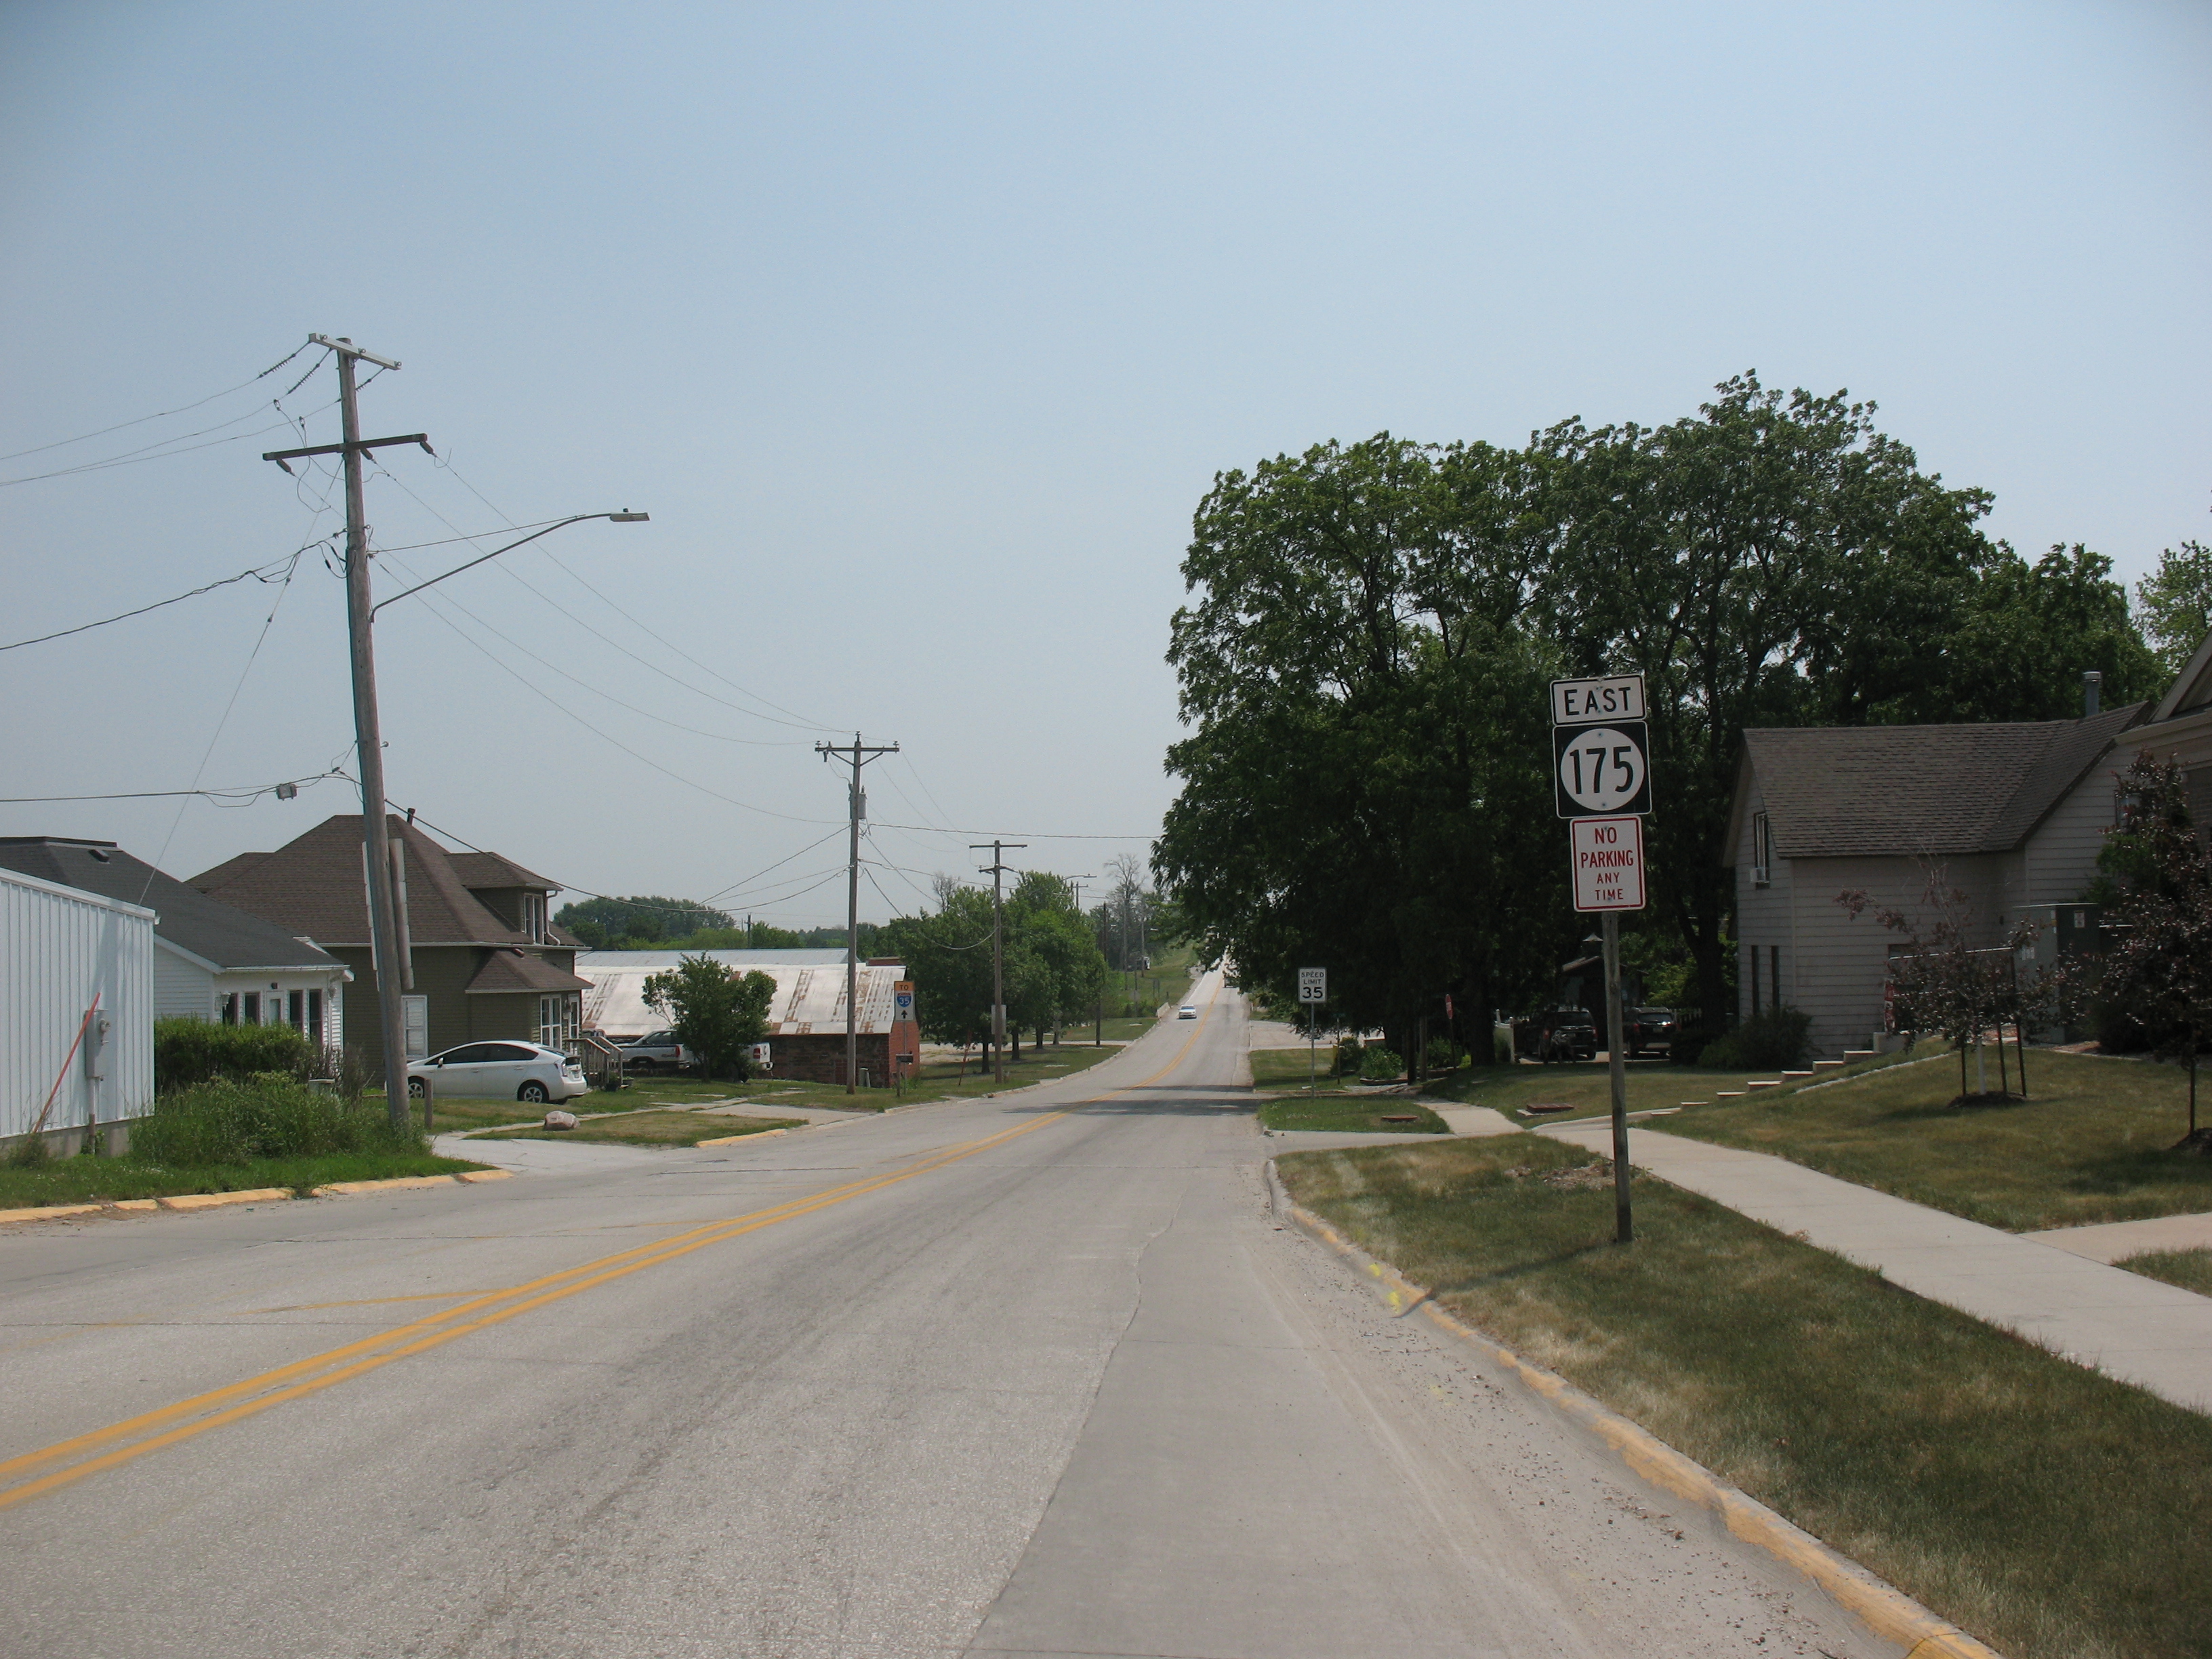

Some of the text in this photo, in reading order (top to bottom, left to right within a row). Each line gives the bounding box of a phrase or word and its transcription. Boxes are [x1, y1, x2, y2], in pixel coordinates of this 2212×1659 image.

[1563, 687, 1631, 716] EAST
[1570, 745, 1634, 795] 175
[1595, 827, 1617, 844] NO
[1581, 850, 1634, 869] PARKING
[1597, 872, 1620, 884] ANY
[1595, 888, 1624, 901] TIME
[1303, 987, 1323, 999] 35
